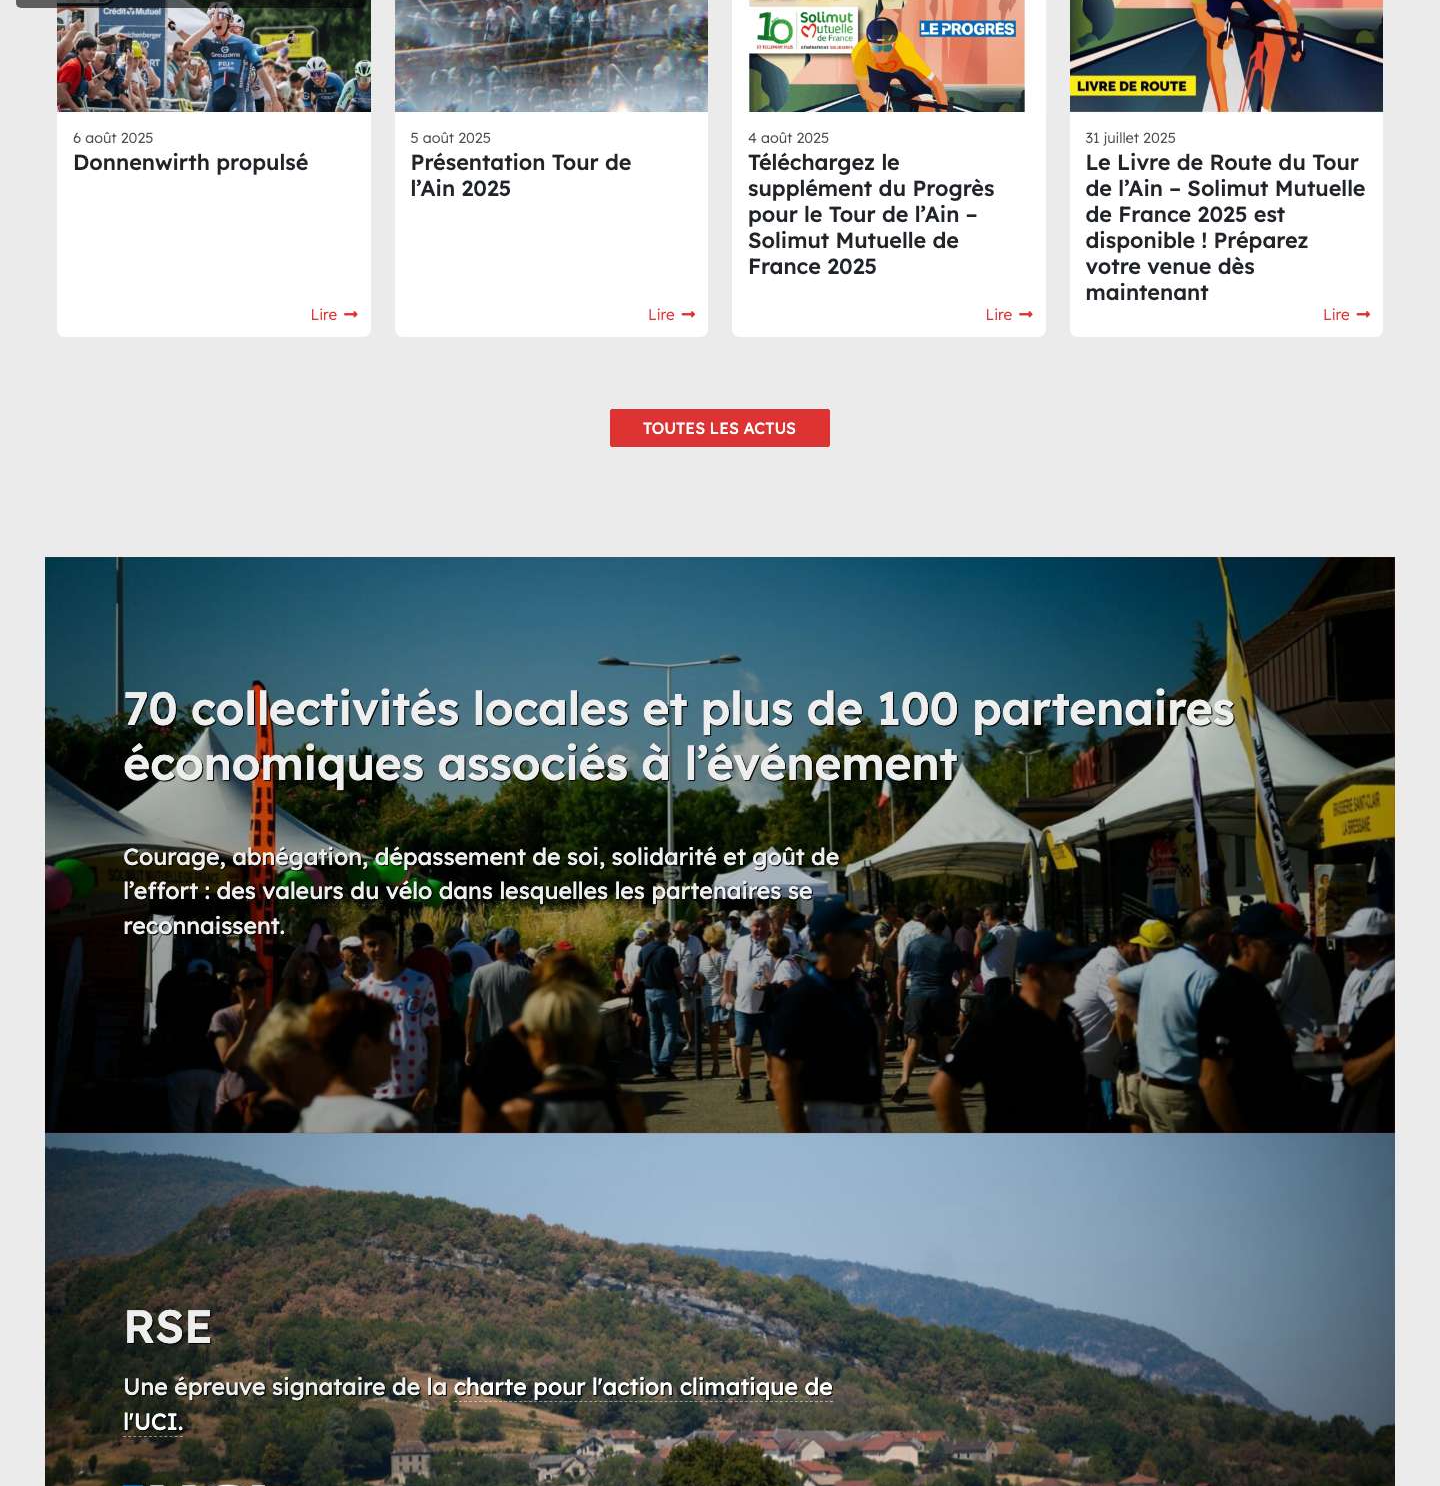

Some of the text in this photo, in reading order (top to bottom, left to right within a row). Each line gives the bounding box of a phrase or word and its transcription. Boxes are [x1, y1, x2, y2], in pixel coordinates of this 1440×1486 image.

[103, 7, 161, 16] Crédit Mutuel
[921, 21, 1015, 36] LE PROGRÈS
[1078, 81, 1116, 92] LIVRE
[1138, 80, 1186, 95] ROUTE
[86, 132, 116, 143] août
[75, 153, 308, 175] Donnenwirth propulsé
[643, 421, 795, 434] TOUTES LES ACTUS
[127, 1310, 210, 1343] RSE
[125, 1412, 182, 1430] l’UCI.
